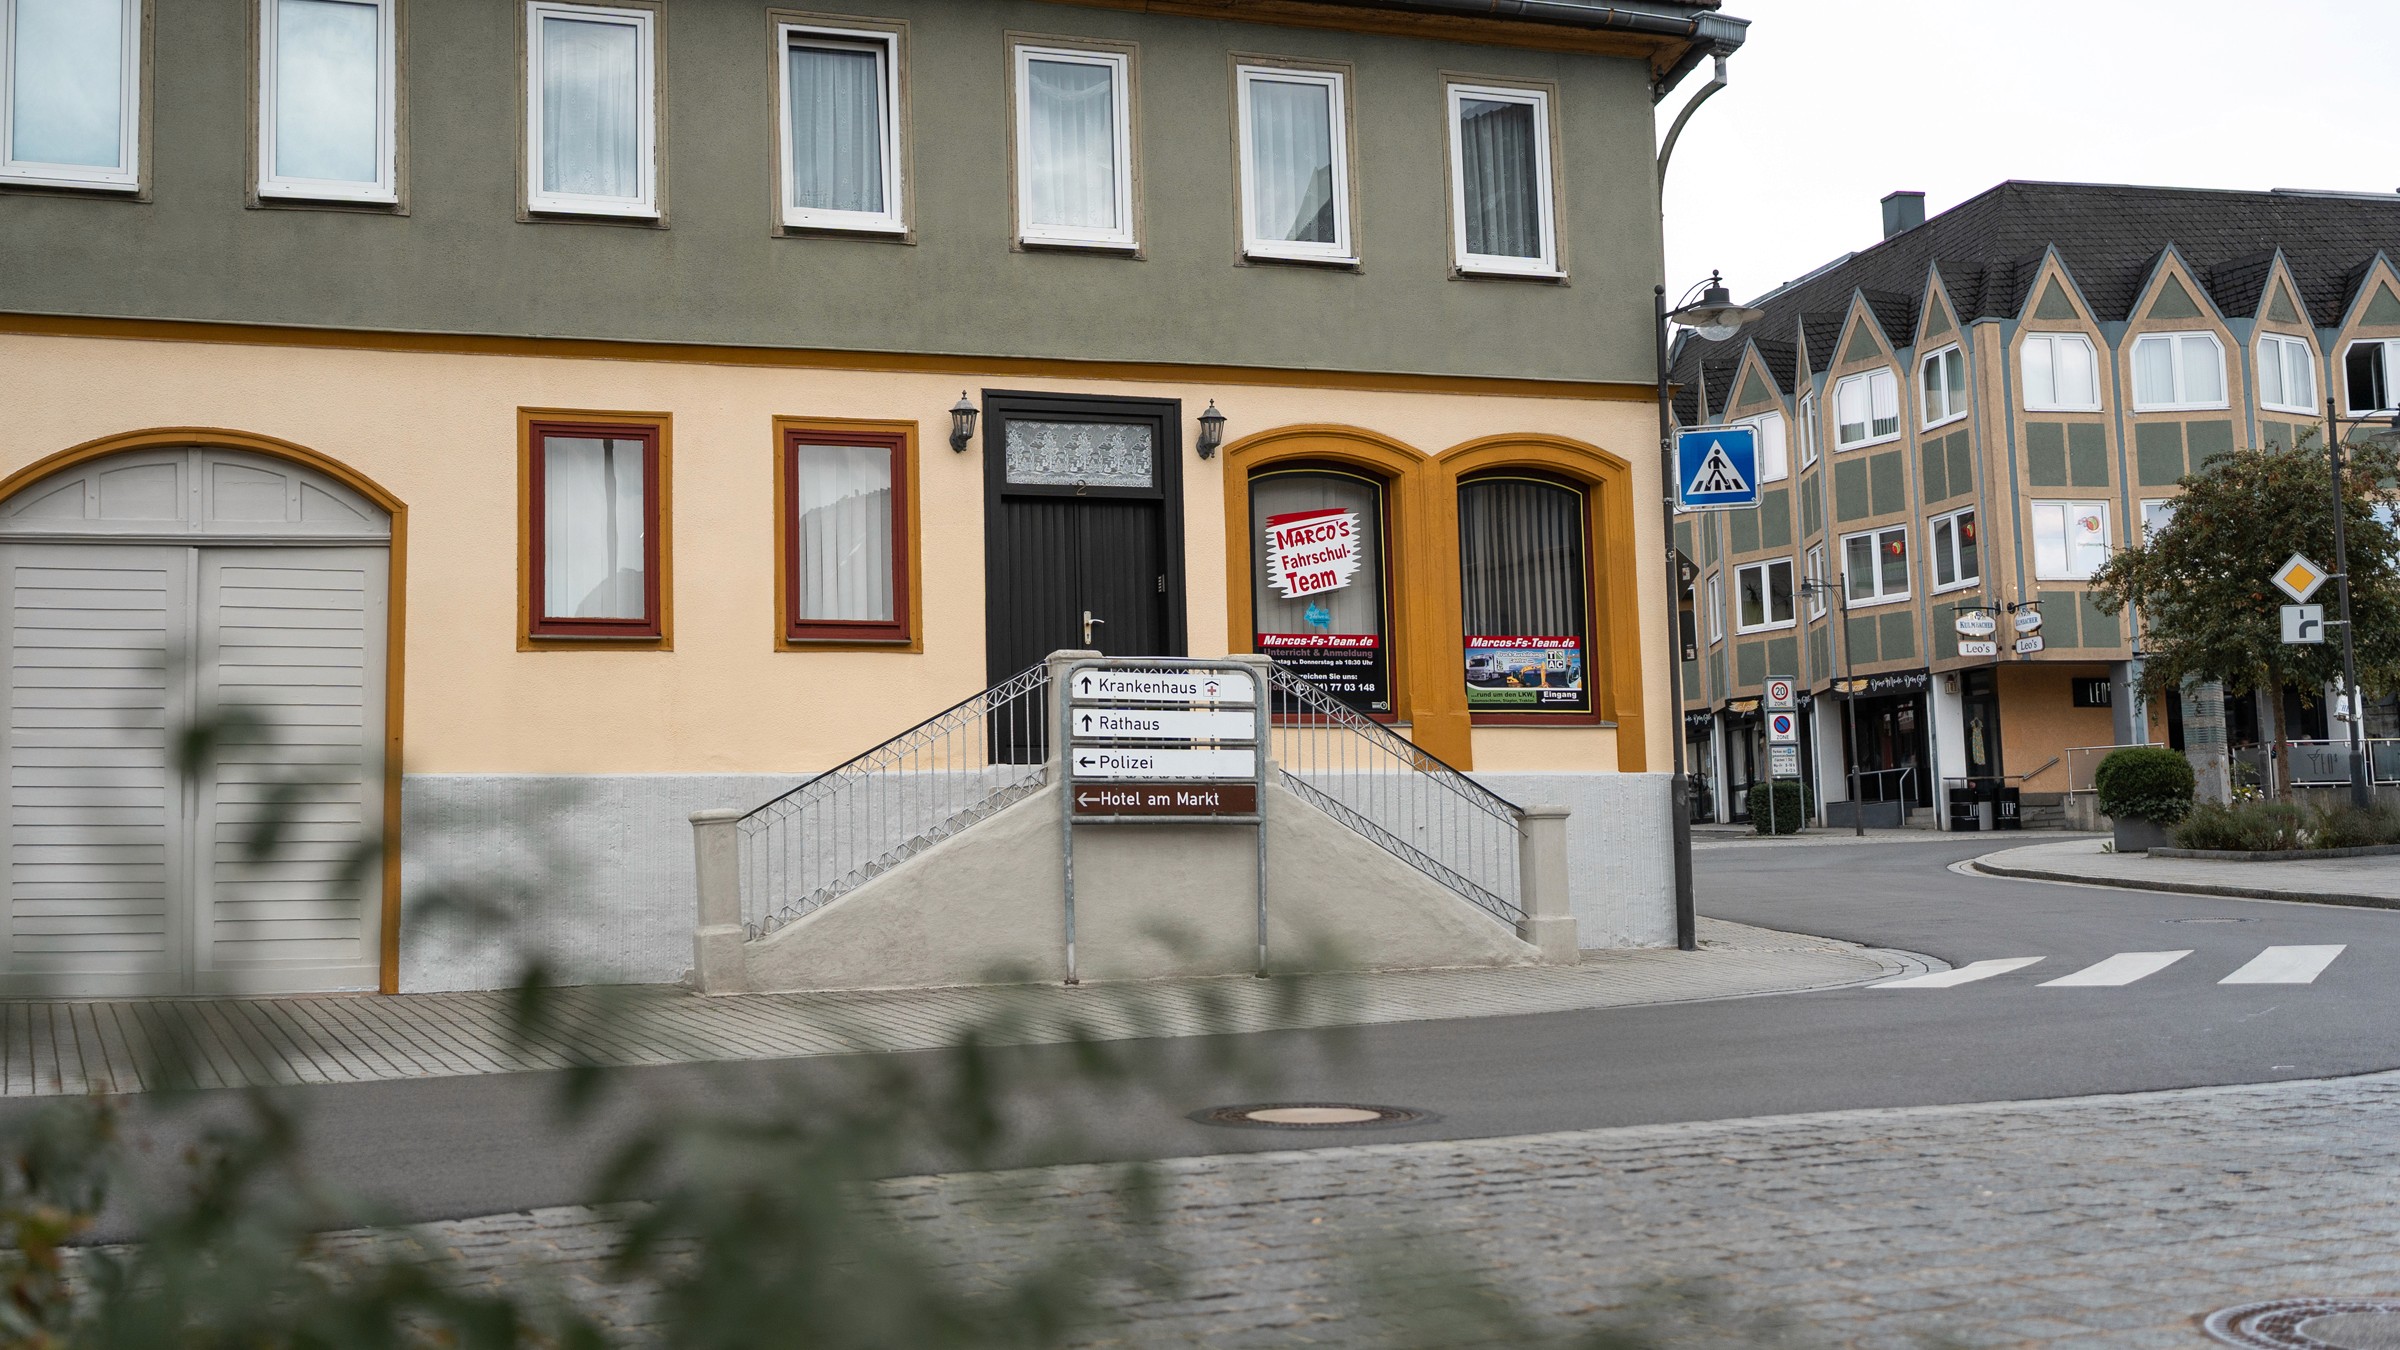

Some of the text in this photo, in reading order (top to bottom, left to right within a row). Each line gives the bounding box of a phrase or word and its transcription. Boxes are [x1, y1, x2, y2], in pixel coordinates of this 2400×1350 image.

[1076, 479, 1087, 497] 2
[1281, 543, 1351, 570] Fahrschul-
[1286, 569, 1338, 594] Team
[1264, 635, 1373, 646] Marcos-Fs-Team.de
[1471, 637, 1575, 648] Marcos-Fs-Team.de
[2020, 640, 2038, 651] Leo's
[1264, 648, 1374, 659] Unterricht & Anmeldung
[1966, 643, 1991, 653] Leo's
[1099, 678, 1197, 694] Krankenhaus
[1344, 683, 1356, 691] 03
[1358, 683, 1376, 691] 148
[1775, 687, 1785, 696] 20
[1543, 690, 1577, 699] Eingang
[1099, 716, 1160, 731] Rathaus
[1099, 755, 1153, 769] Polizei
[1100, 791, 1219, 806] Hotel am Markt
